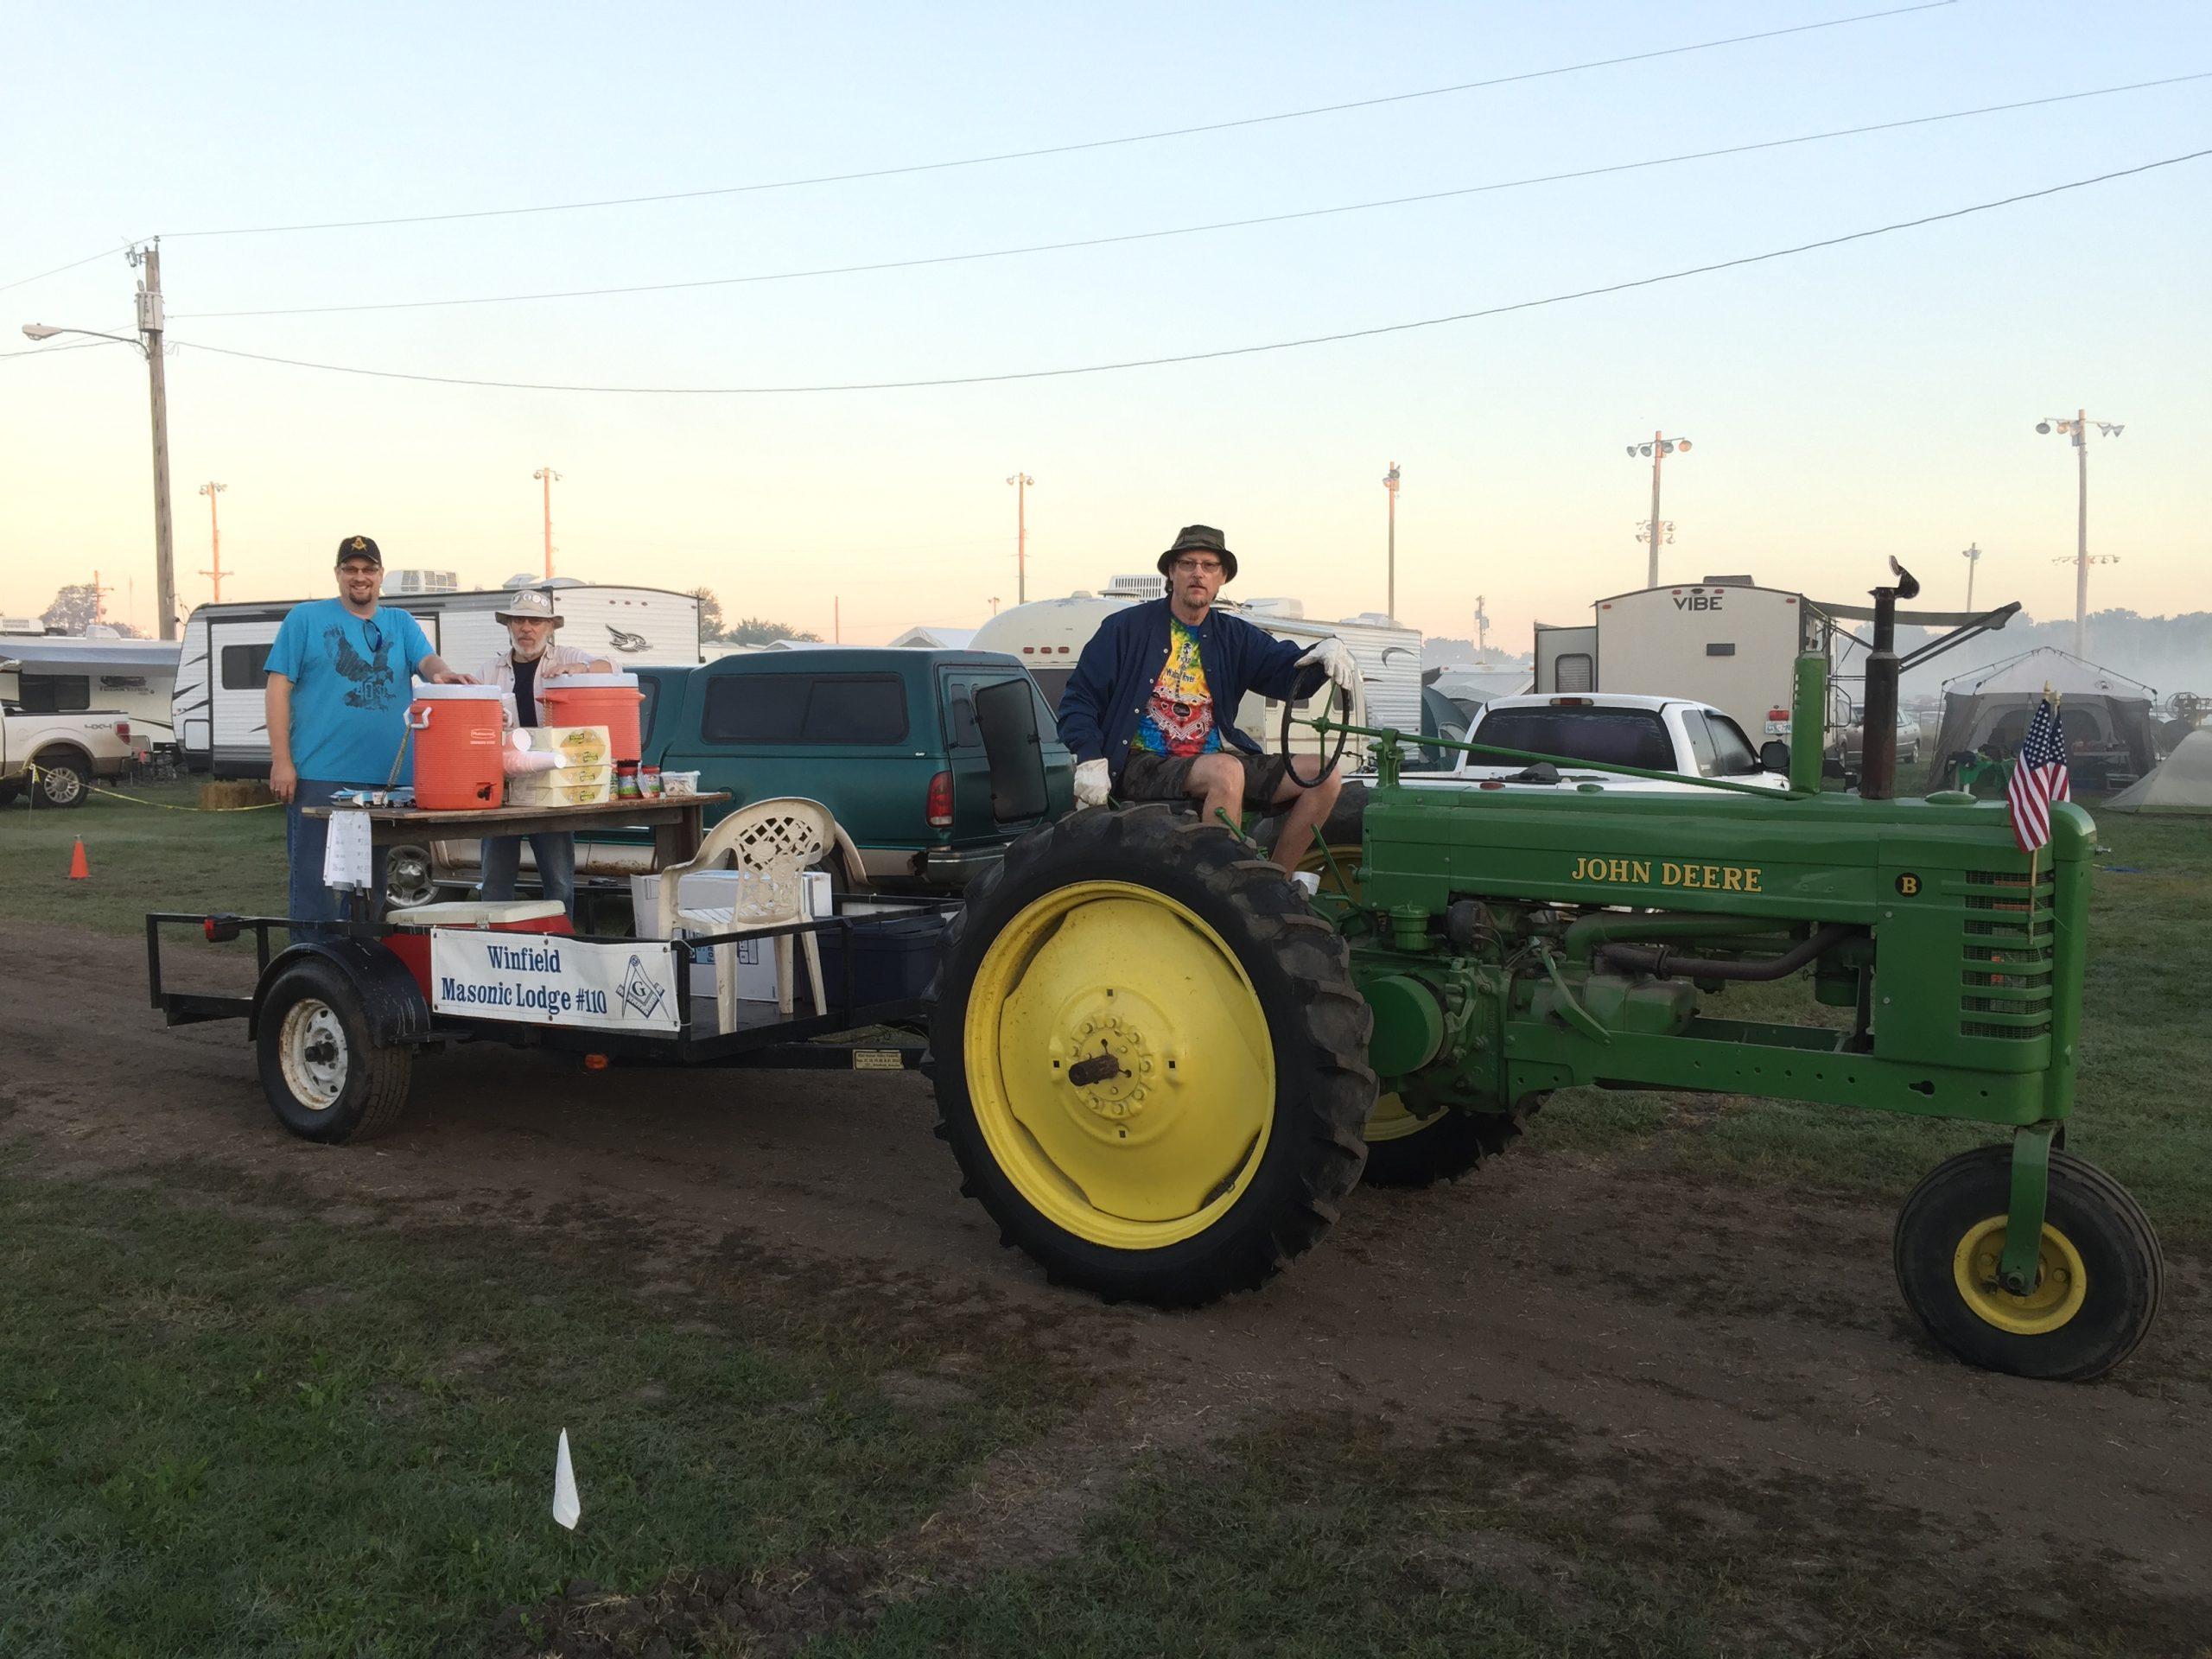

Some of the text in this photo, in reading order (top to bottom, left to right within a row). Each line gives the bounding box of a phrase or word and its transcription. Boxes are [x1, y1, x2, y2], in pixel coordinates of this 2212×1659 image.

[1673, 596, 1723, 611] VIBE
[1572, 857, 1763, 893] JOHN DEERE
[1902, 877, 1916, 893] B
[487, 944, 562, 974] Winfield
[442, 977, 607, 1015] Masonic Lodge #110
[632, 982, 647, 996] G
